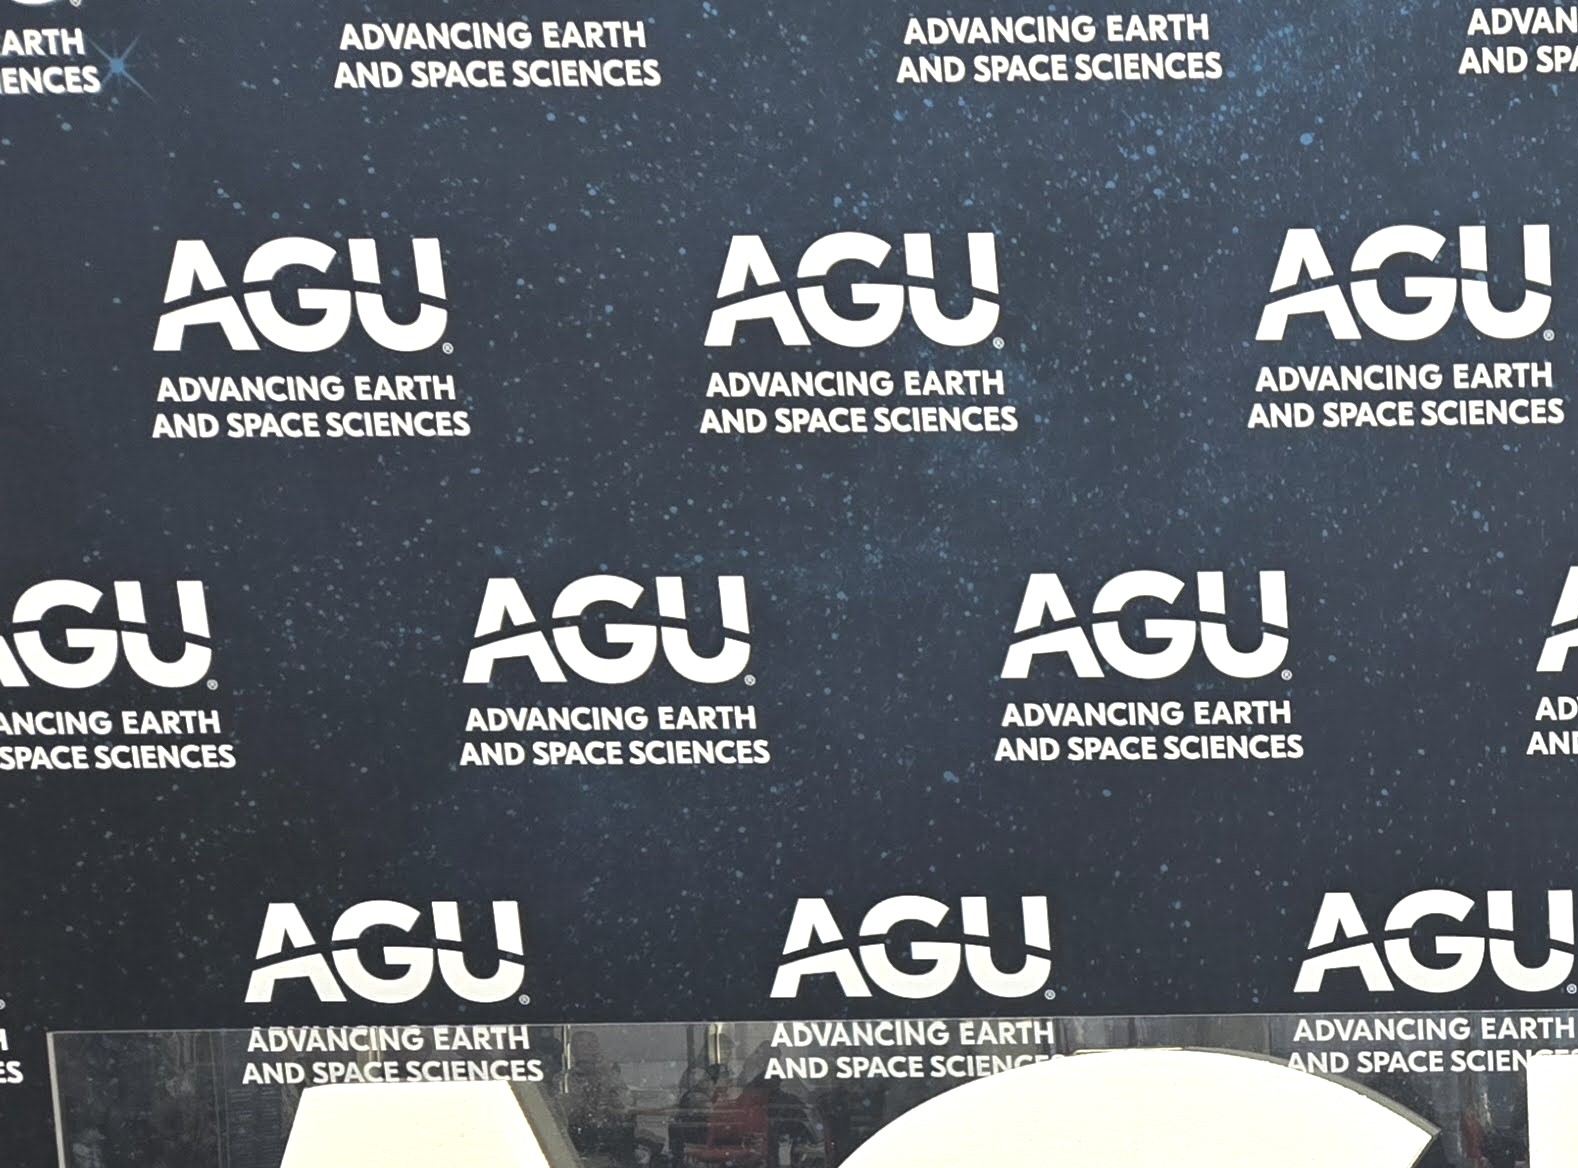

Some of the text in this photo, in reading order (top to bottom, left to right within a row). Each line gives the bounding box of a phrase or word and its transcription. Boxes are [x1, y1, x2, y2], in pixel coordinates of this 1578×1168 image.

[0, 28, 85, 56] ARTH
[340, 21, 646, 50] ADVANCING EARTH
[904, 14, 1209, 44] ADVANCING EARTH
[334, 59, 661, 88] AND SPACE SCIENCES
[897, 52, 1222, 83] AND SPACE SCIENCES
[1459, 47, 1528, 74] AND
[153, 237, 447, 352] AGU
[704, 232, 999, 347] AGU
[1255, 224, 1551, 340] AGU
[157, 375, 456, 402] ADVANCING EARTH
[706, 370, 1004, 397] ADVANCING EARTH
[1256, 362, 1552, 392] ADVANCING EARTH
[152, 411, 470, 438] AND SPACE SCIENCES
[700, 406, 1018, 433] AND SPACE SCIENCES
[1248, 398, 1564, 428] AND SPACE SCIENCES
[463, 575, 750, 684] AGU
[1001, 570, 1288, 679] AGU
[122, 710, 220, 734] EARTH
[466, 706, 756, 731] ADVANCING EARTH
[1002, 700, 1290, 726] ADVANCING EARTH
[0, 745, 236, 770] SPACE SCIENCES
[460, 740, 770, 765] AND SPACE SCIENCES
[995, 734, 1303, 761] AND SPACE SCIENCES
[245, 900, 524, 1003] AGU
[770, 896, 1051, 998] AGU
[1294, 890, 1574, 993] AGU
[247, 1024, 530, 1052] ADVANCING EARTH
[770, 1018, 1055, 1047] ADVANCING EARTH
[1293, 1017, 1575, 1041] ADVANCING EARTH
[242, 1059, 544, 1084] AND SPACE SCIENCES
[765, 1057, 828, 1079] AND
[837, 1056, 924, 1078] SPACE
[1288, 1052, 1349, 1074] AND
[1357, 1050, 1444, 1073] SPACE
